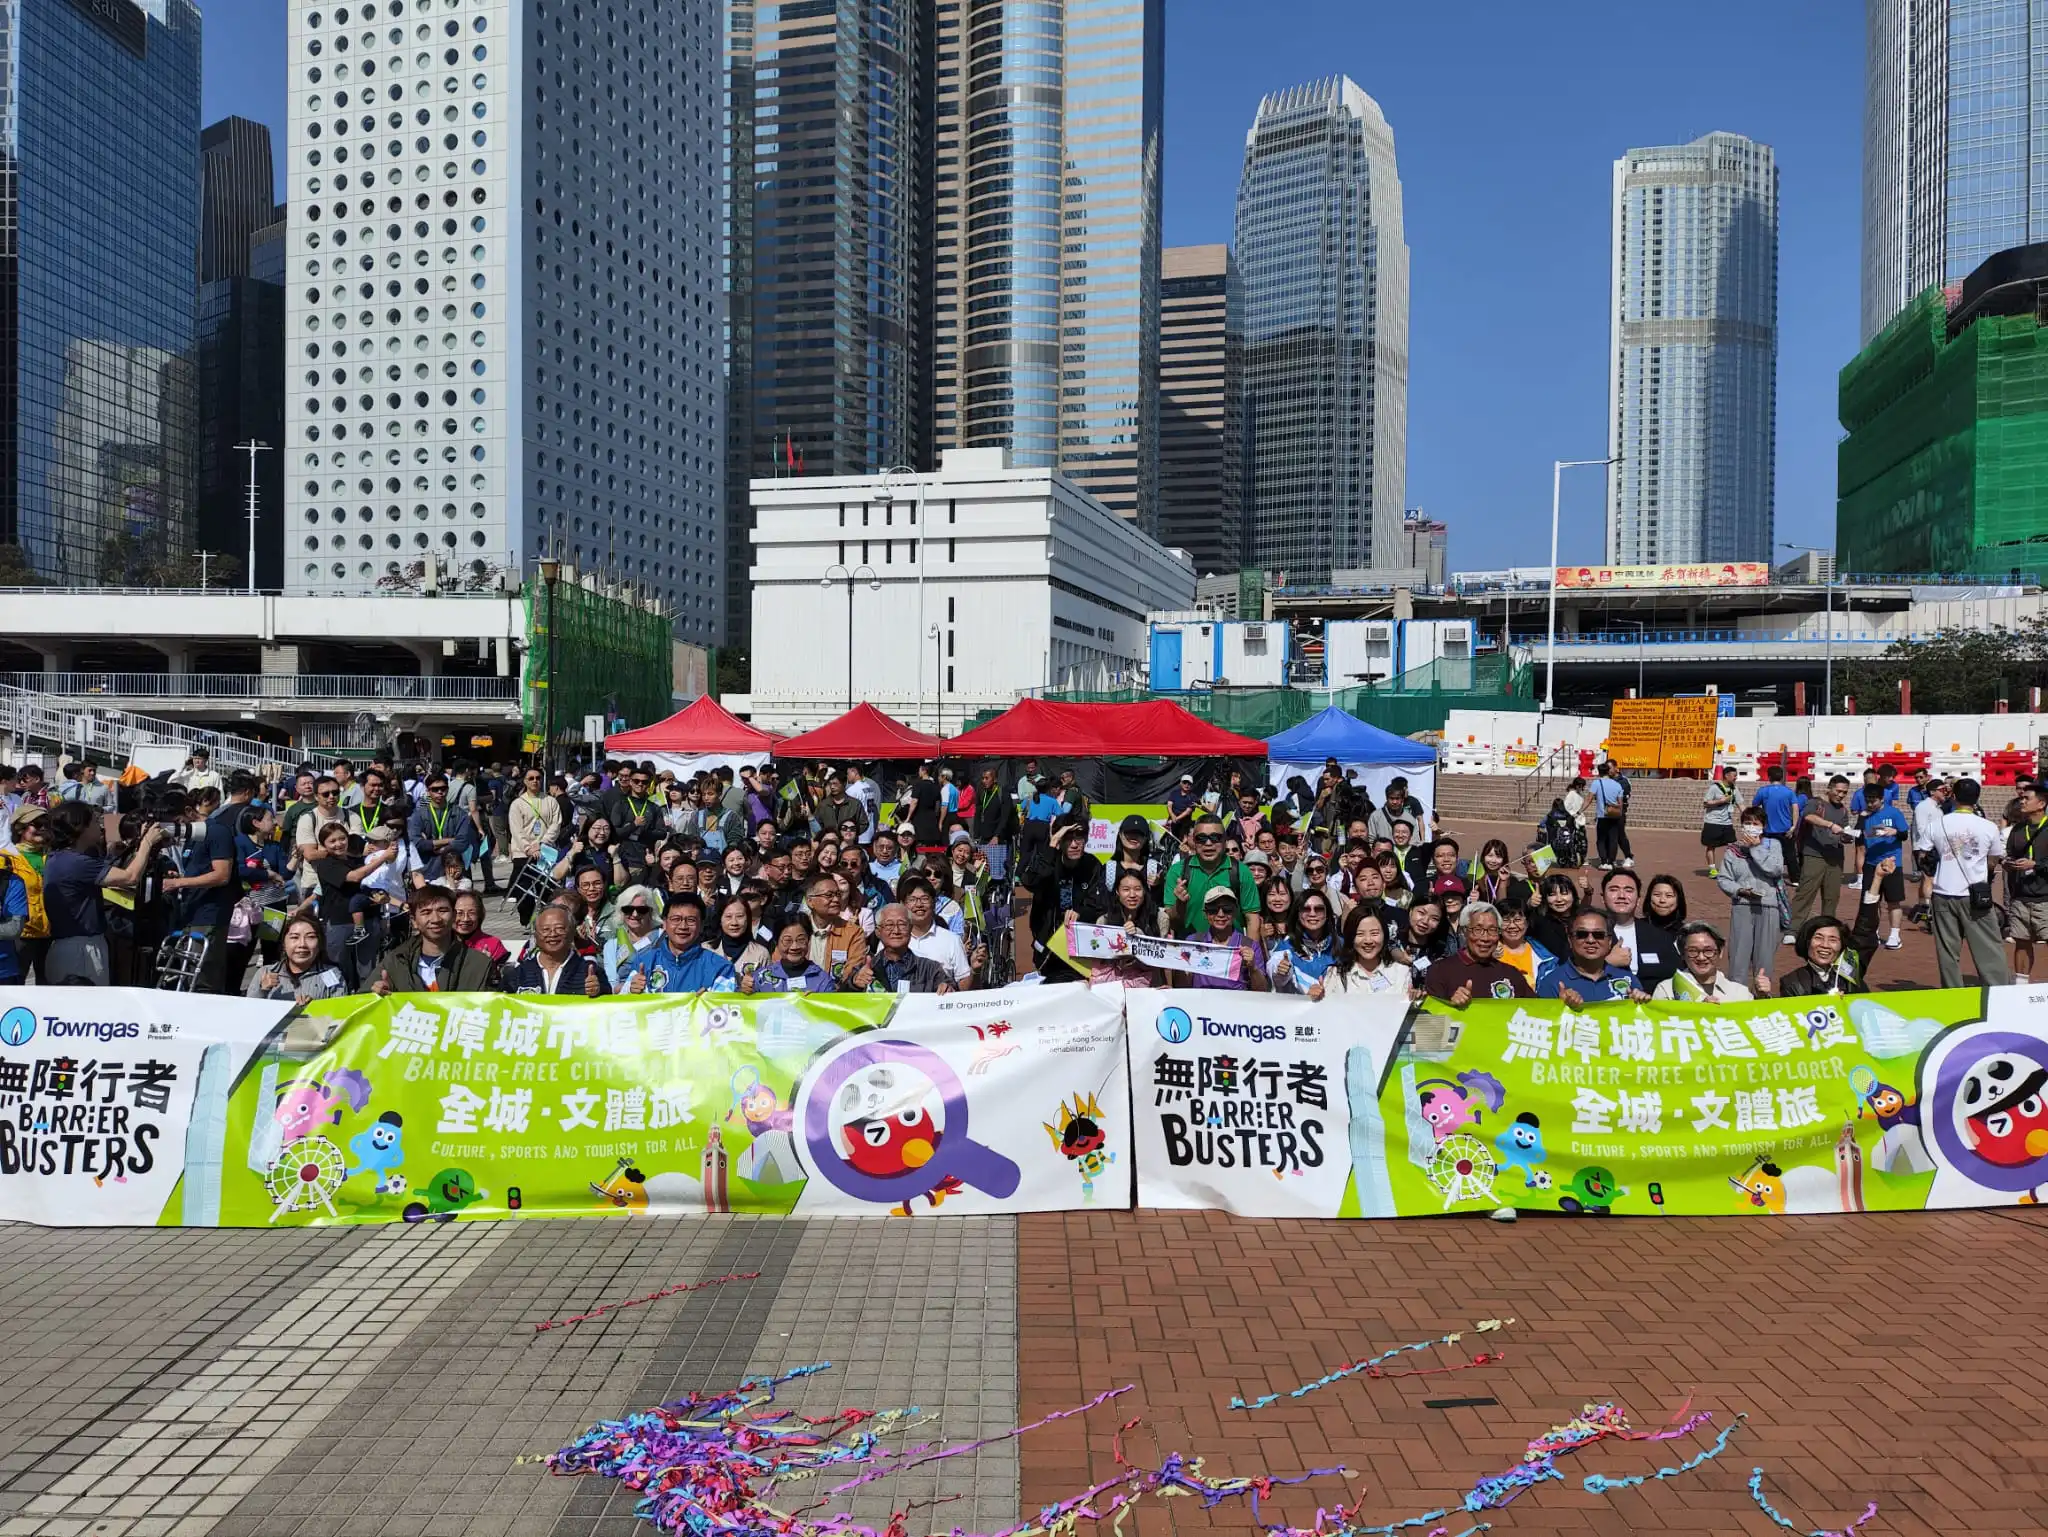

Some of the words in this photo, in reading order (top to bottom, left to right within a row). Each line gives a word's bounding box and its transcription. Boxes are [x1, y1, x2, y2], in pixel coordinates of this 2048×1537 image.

[956, 1000, 1001, 1010] Organized
[43, 1016, 140, 1042] Towngas
[1197, 1017, 1287, 1043] Towngas
[0, 1056, 178, 1114] 無障行者
[404, 1058, 560, 1083] BARRIER-FREE
[1153, 1052, 1328, 1111] 無障行者
[1531, 1060, 1685, 1086] BARRIER-FREE
[1695, 1062, 1740, 1084] CITY
[1748, 1055, 1848, 1081] EXPLORER
[19, 1103, 129, 1135] BARRIER
[1190, 1098, 1296, 1130] BARRIER
[0, 1120, 160, 1182] BUSTERS
[500, 1145, 548, 1159] SPORTS
[554, 1145, 579, 1159] AND
[585, 1141, 638, 1157] TOURISM
[646, 1139, 669, 1155] FOR
[674, 1137, 698, 1152] ALL
[1161, 1113, 1325, 1174] BUSTERS
[1640, 1145, 1688, 1159] SPORTS
[1693, 1145, 1718, 1159] AND
[1723, 1141, 1776, 1157] TOURISM
[1783, 1138, 1806, 1152] FOR
[1810, 1134, 1832, 1148] ALL
